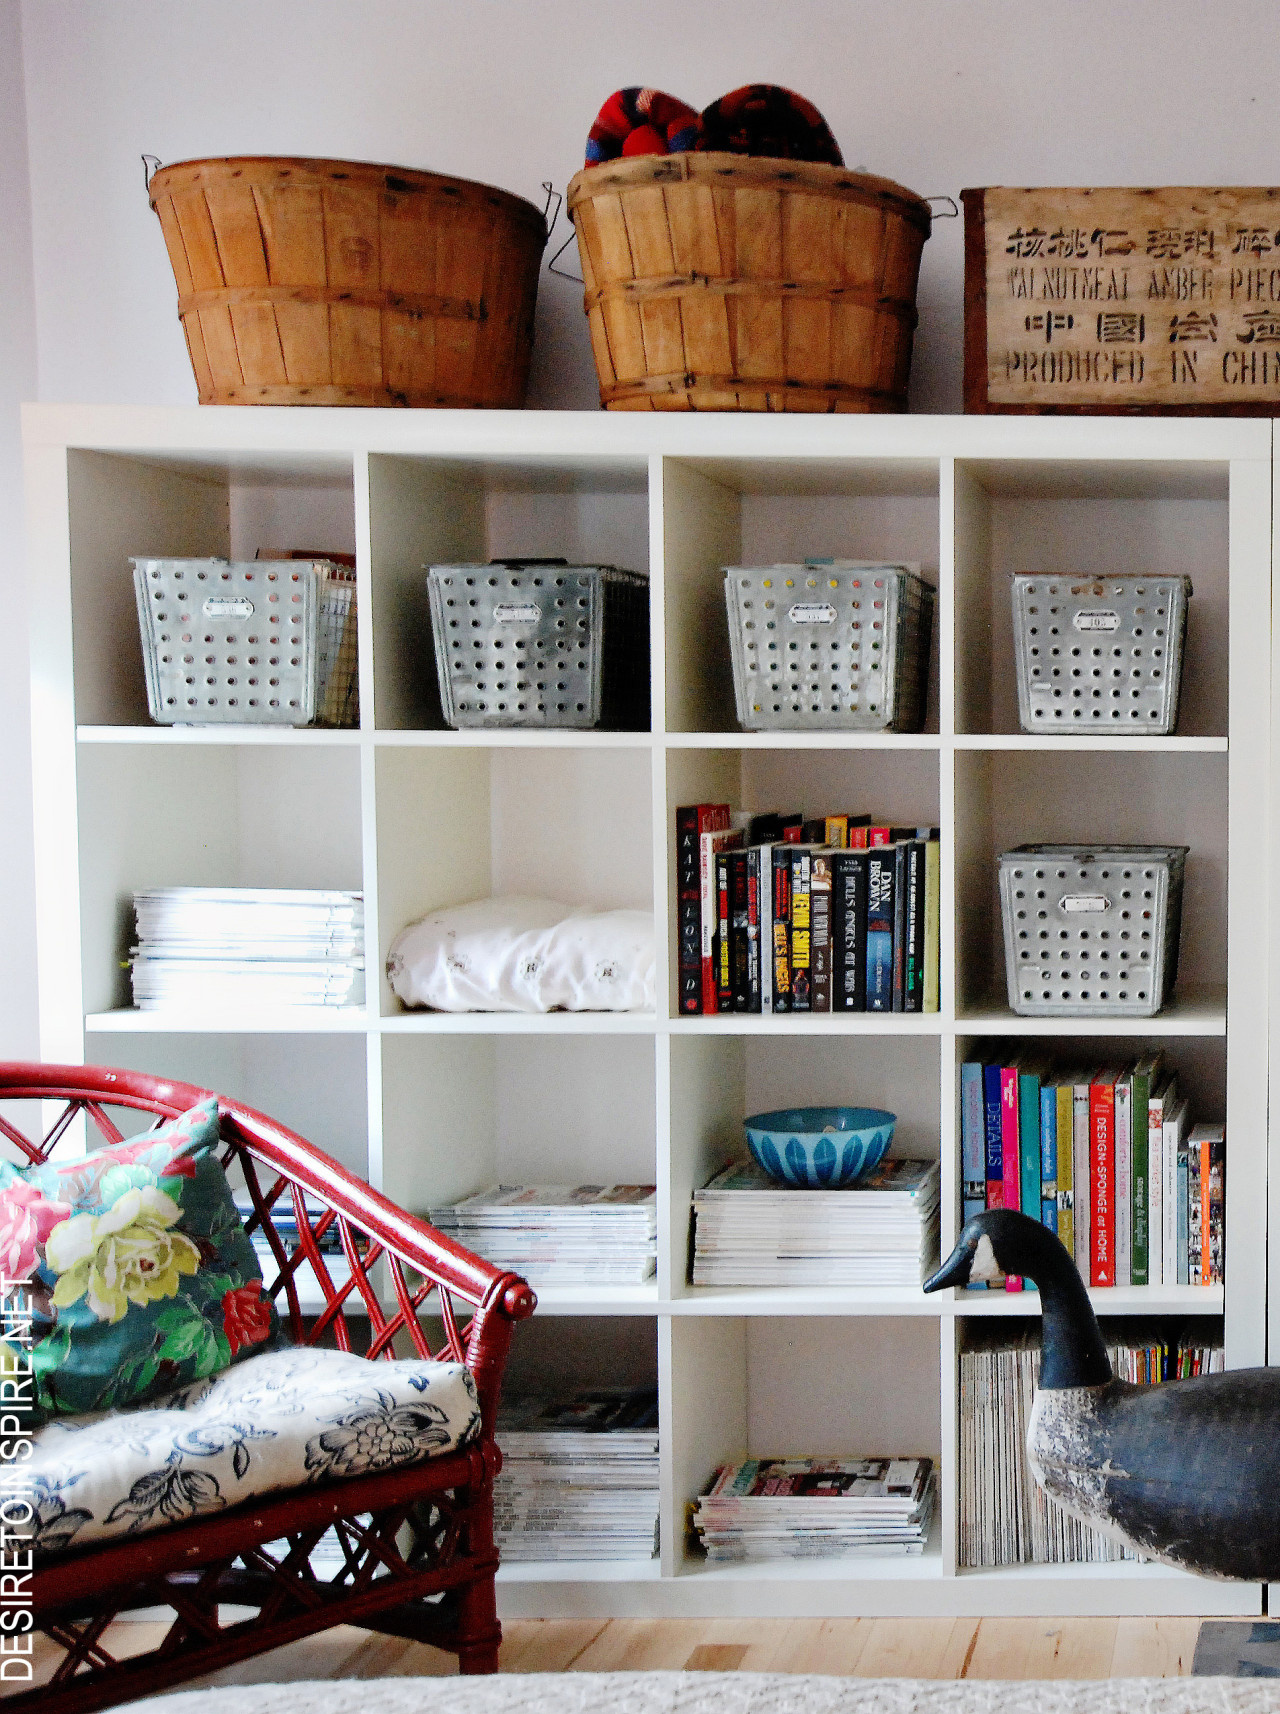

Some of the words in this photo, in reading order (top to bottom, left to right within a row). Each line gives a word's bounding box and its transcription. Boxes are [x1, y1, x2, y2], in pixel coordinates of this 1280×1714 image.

[1006, 351, 1145, 383] PRODUCED
[1171, 351, 1198, 383] IN
[869, 860, 881, 912] BROWN
[880, 871, 892, 901] DAN
[792, 894, 809, 928] KEVIN
[792, 931, 809, 968] SMITH
[987, 1103, 1001, 1167] DETAILS
[1097, 1216, 1105, 1228] at
[1097, 1229, 1107, 1262] HOME
